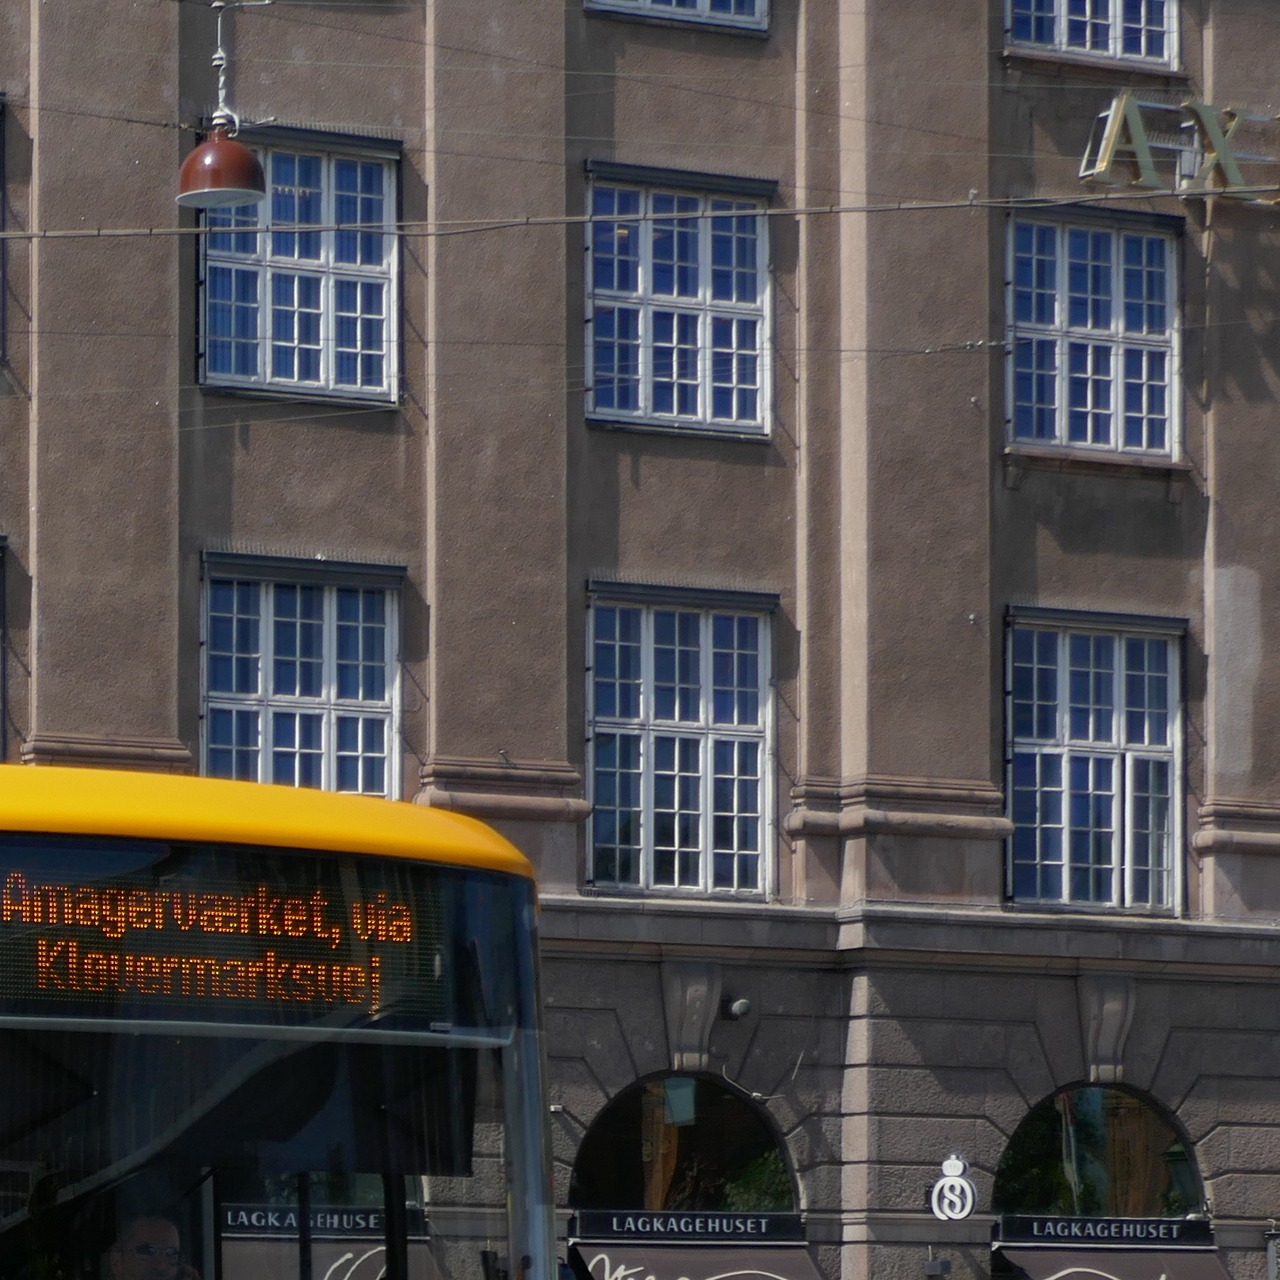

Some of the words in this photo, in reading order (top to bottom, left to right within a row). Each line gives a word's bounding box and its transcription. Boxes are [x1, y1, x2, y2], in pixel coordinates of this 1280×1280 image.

[1, 871, 341, 950] Amagerværket,
[351, 891, 413, 943] via
[36, 938, 381, 1016] Kløvermarksvej
[227, 1211, 387, 1229] LAGKAEHUSE
[612, 1217, 768, 1233] LAGKAGEHUSET
[1033, 1222, 1180, 1239] LAGKAGEHUSET
